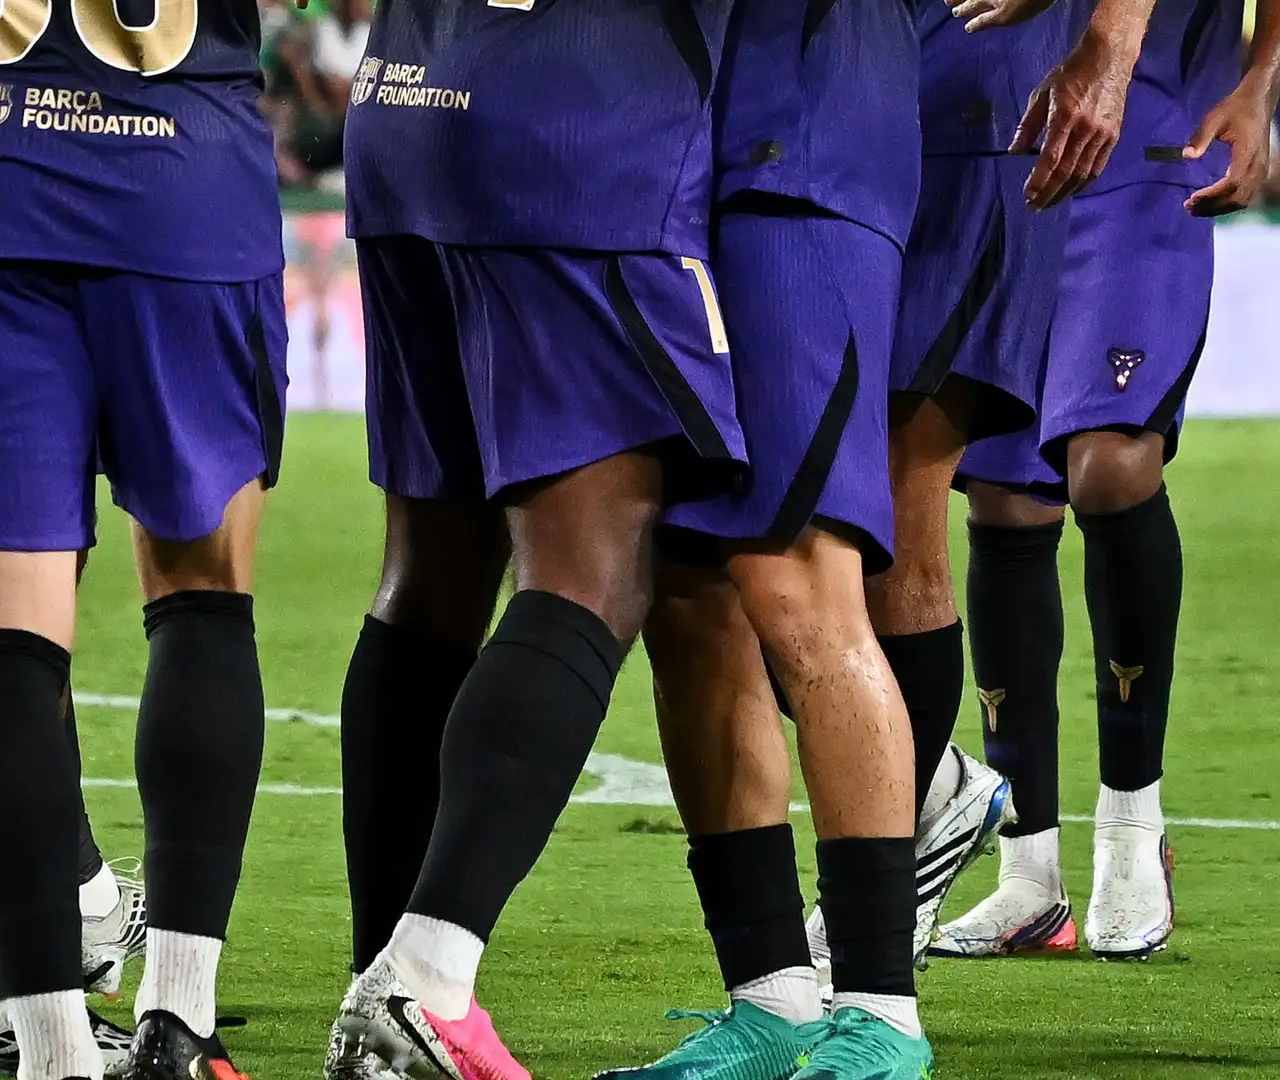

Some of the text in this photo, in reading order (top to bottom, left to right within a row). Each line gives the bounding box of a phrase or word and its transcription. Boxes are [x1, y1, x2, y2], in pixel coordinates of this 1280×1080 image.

[382, 63, 426, 86] BARÇA
[24, 87, 103, 114] BARÇA
[376, 85, 471, 110] FOUNDATION
[22, 108, 176, 137] FOUNDATION
